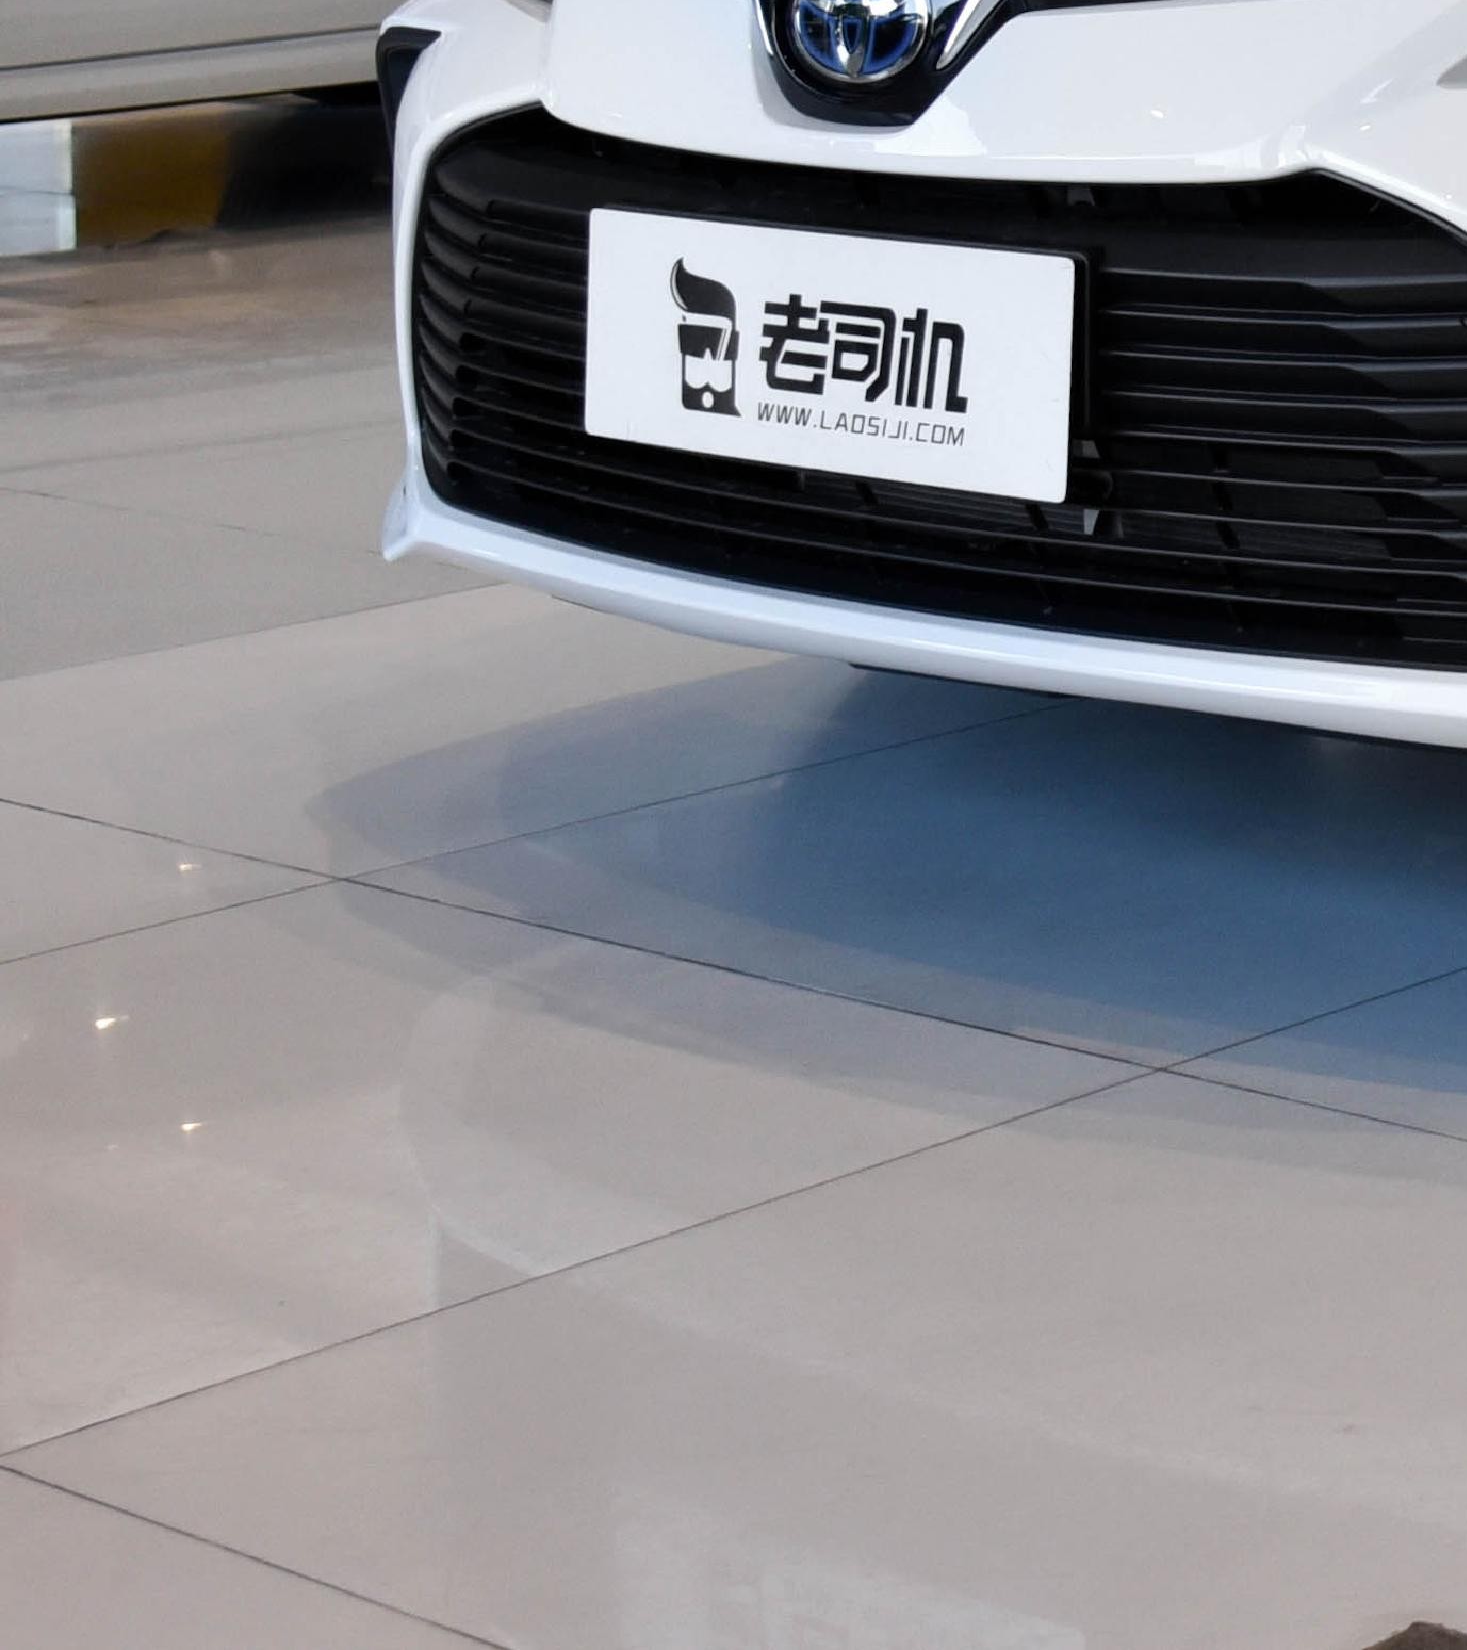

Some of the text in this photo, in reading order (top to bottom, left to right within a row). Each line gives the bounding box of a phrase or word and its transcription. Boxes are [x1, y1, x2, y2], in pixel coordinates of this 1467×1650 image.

[759, 293, 968, 413] 老司机
[757, 401, 966, 447] WWW.LAOSIJI.COM
